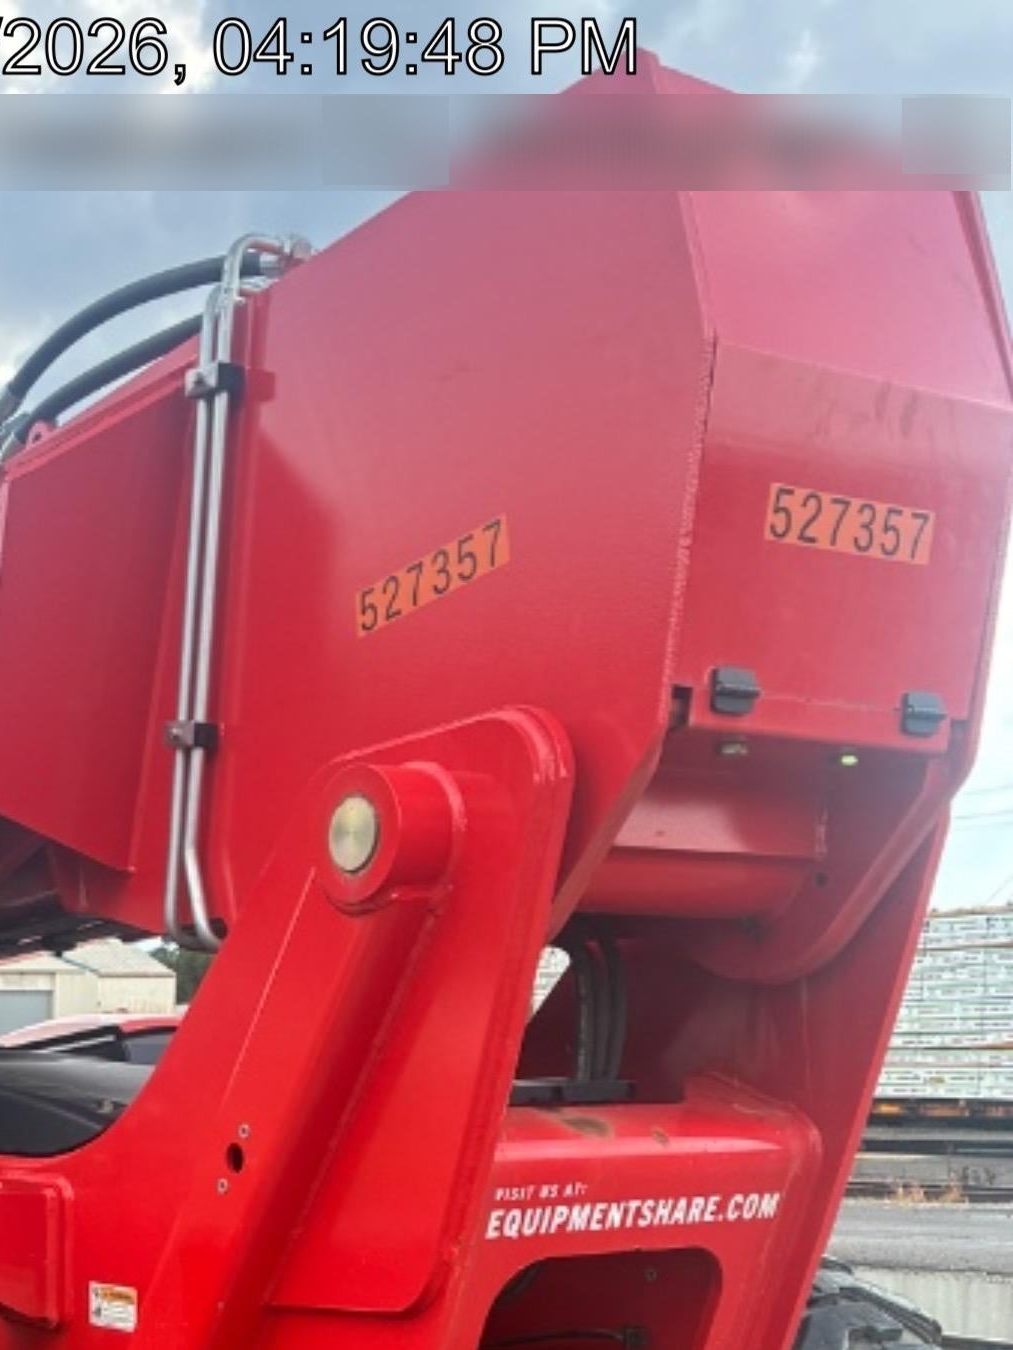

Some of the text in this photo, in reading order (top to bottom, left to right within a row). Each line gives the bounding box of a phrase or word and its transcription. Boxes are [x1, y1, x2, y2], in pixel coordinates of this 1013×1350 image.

[769, 486, 930, 561] 527357
[360, 517, 502, 632] 527357
[484, 1191, 780, 1240] EQUIPMENTSHARE.COM
[494, 1183, 535, 1201] VISIT
